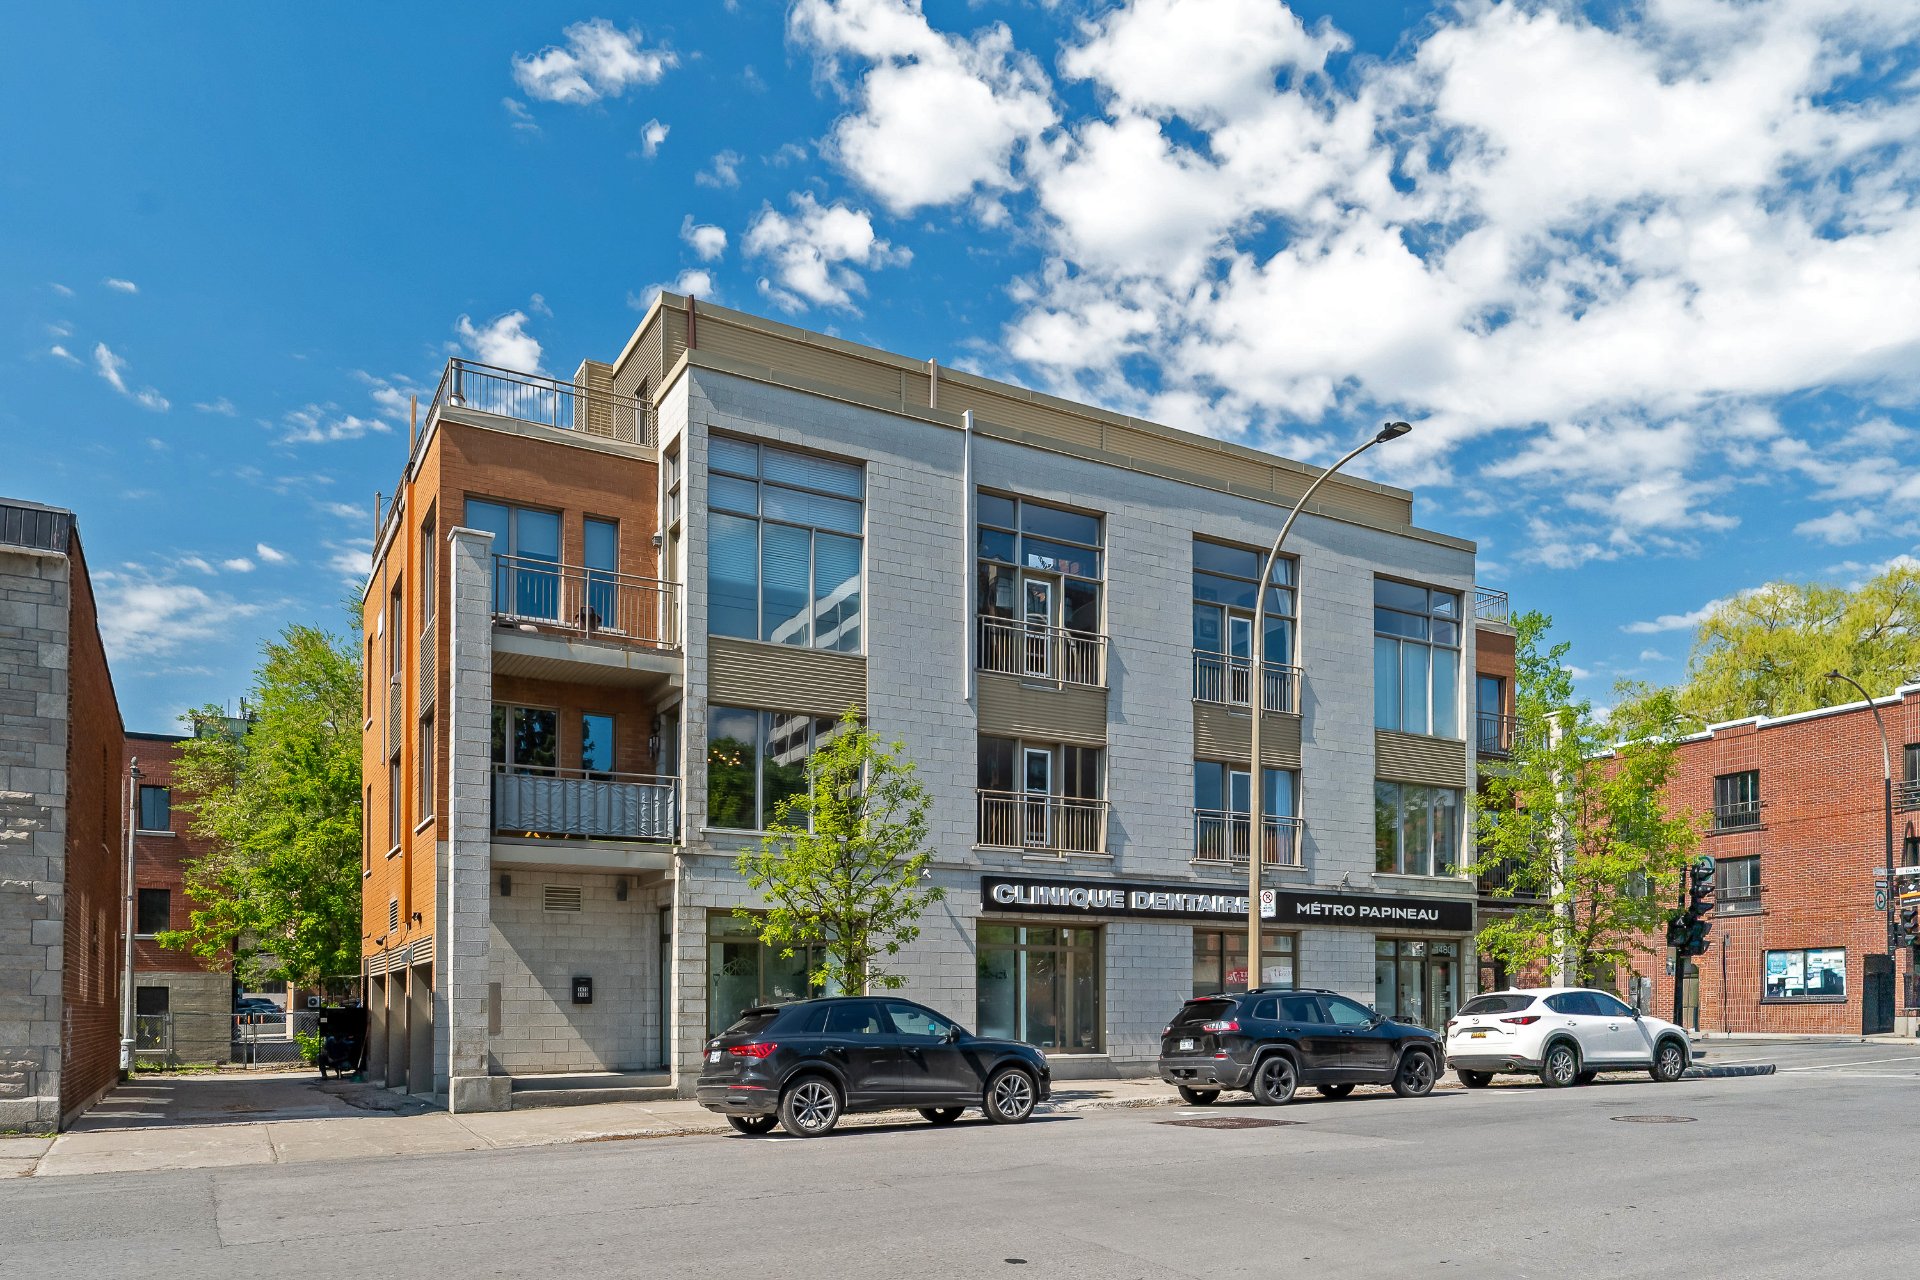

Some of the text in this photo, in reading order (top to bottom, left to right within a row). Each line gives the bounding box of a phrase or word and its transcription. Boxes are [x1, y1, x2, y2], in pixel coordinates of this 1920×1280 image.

[993, 884, 1250, 914] CLINIQUE DENTAIRE
[1296, 901, 1439, 921] MÉTRO PAPINEAU
[1435, 945, 1453, 955] 1480
